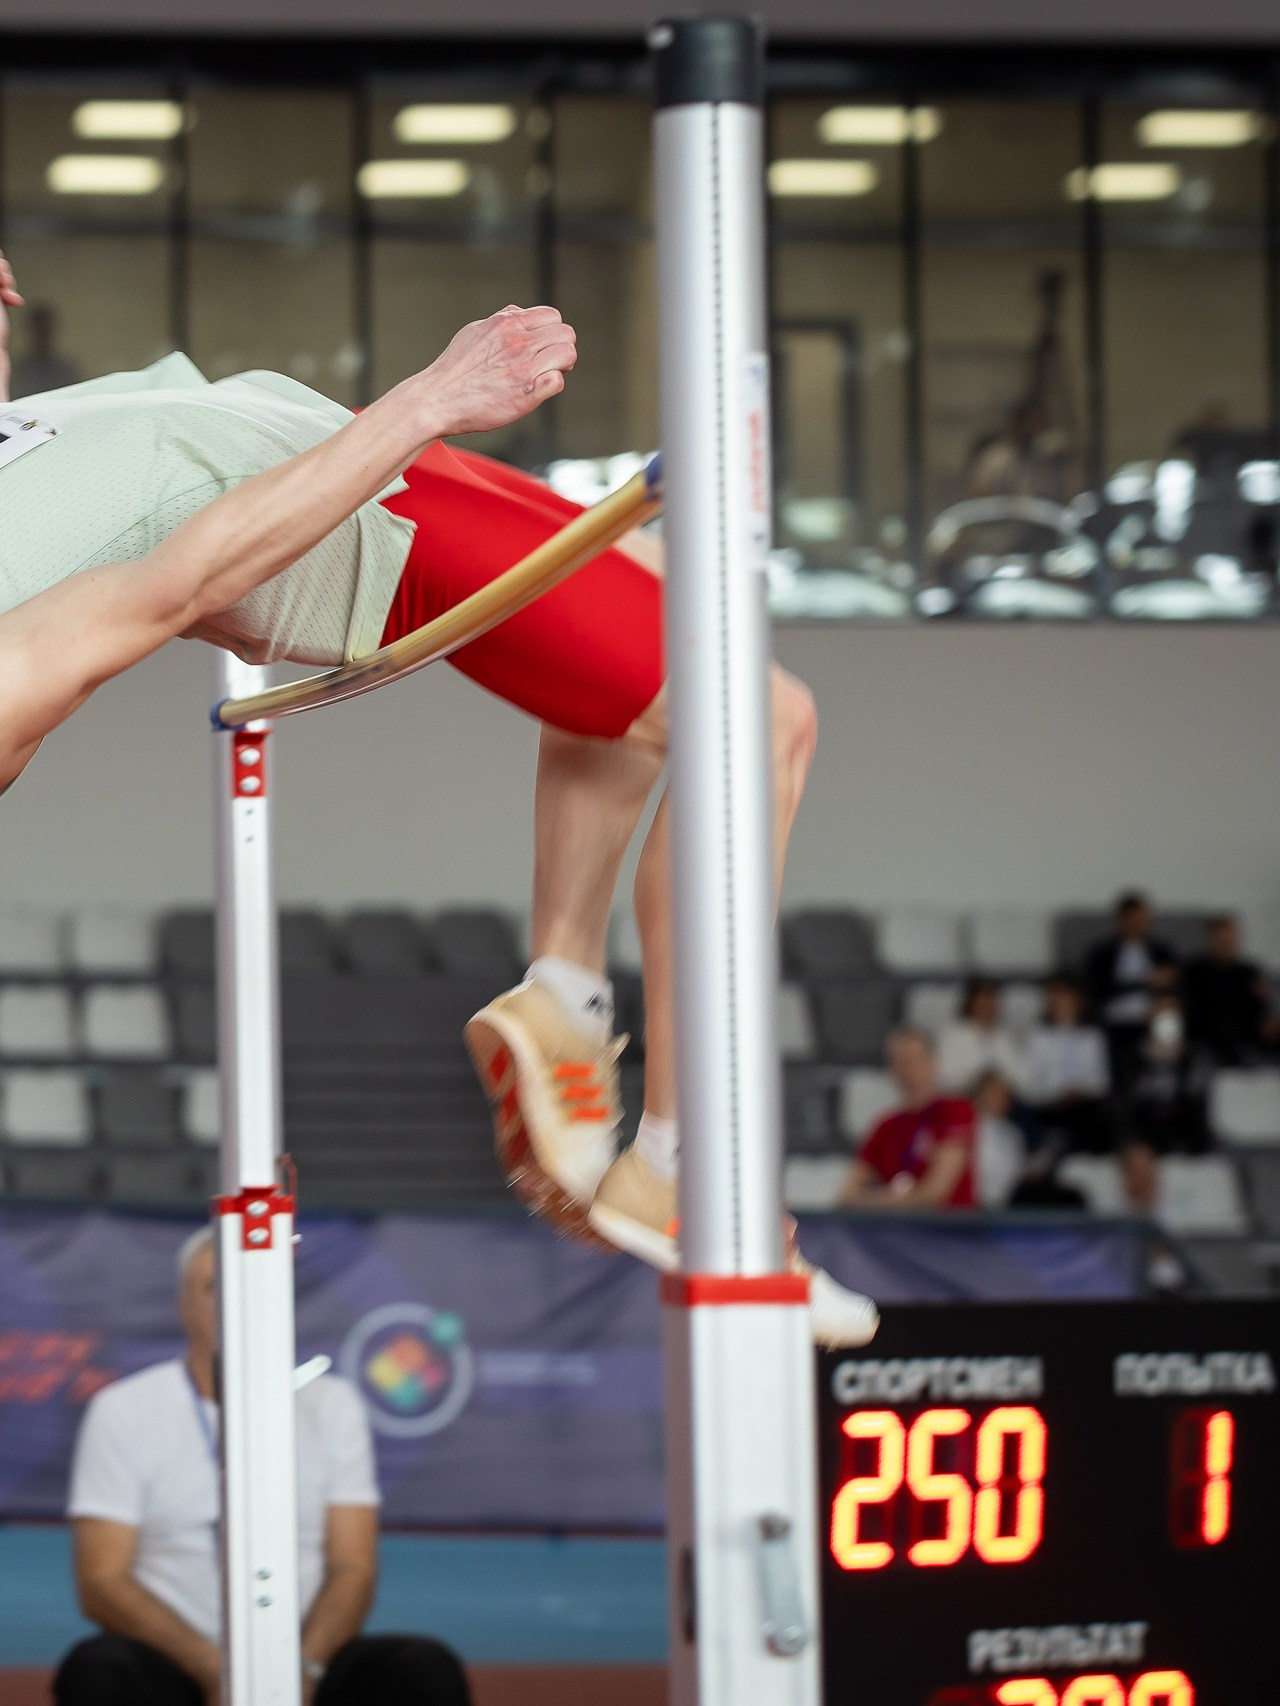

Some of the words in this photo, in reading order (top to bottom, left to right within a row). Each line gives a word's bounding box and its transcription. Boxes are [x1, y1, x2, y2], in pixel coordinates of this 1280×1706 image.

[833, 1357, 1043, 1402] СПОРТСМЕН
[1115, 1353, 1275, 1396] ПОПЫТКА
[831, 1406, 1047, 1570] 250
[1202, 1411, 1234, 1545] 1
[968, 1622, 1148, 1671] РЕЗУЛЬТАТ
